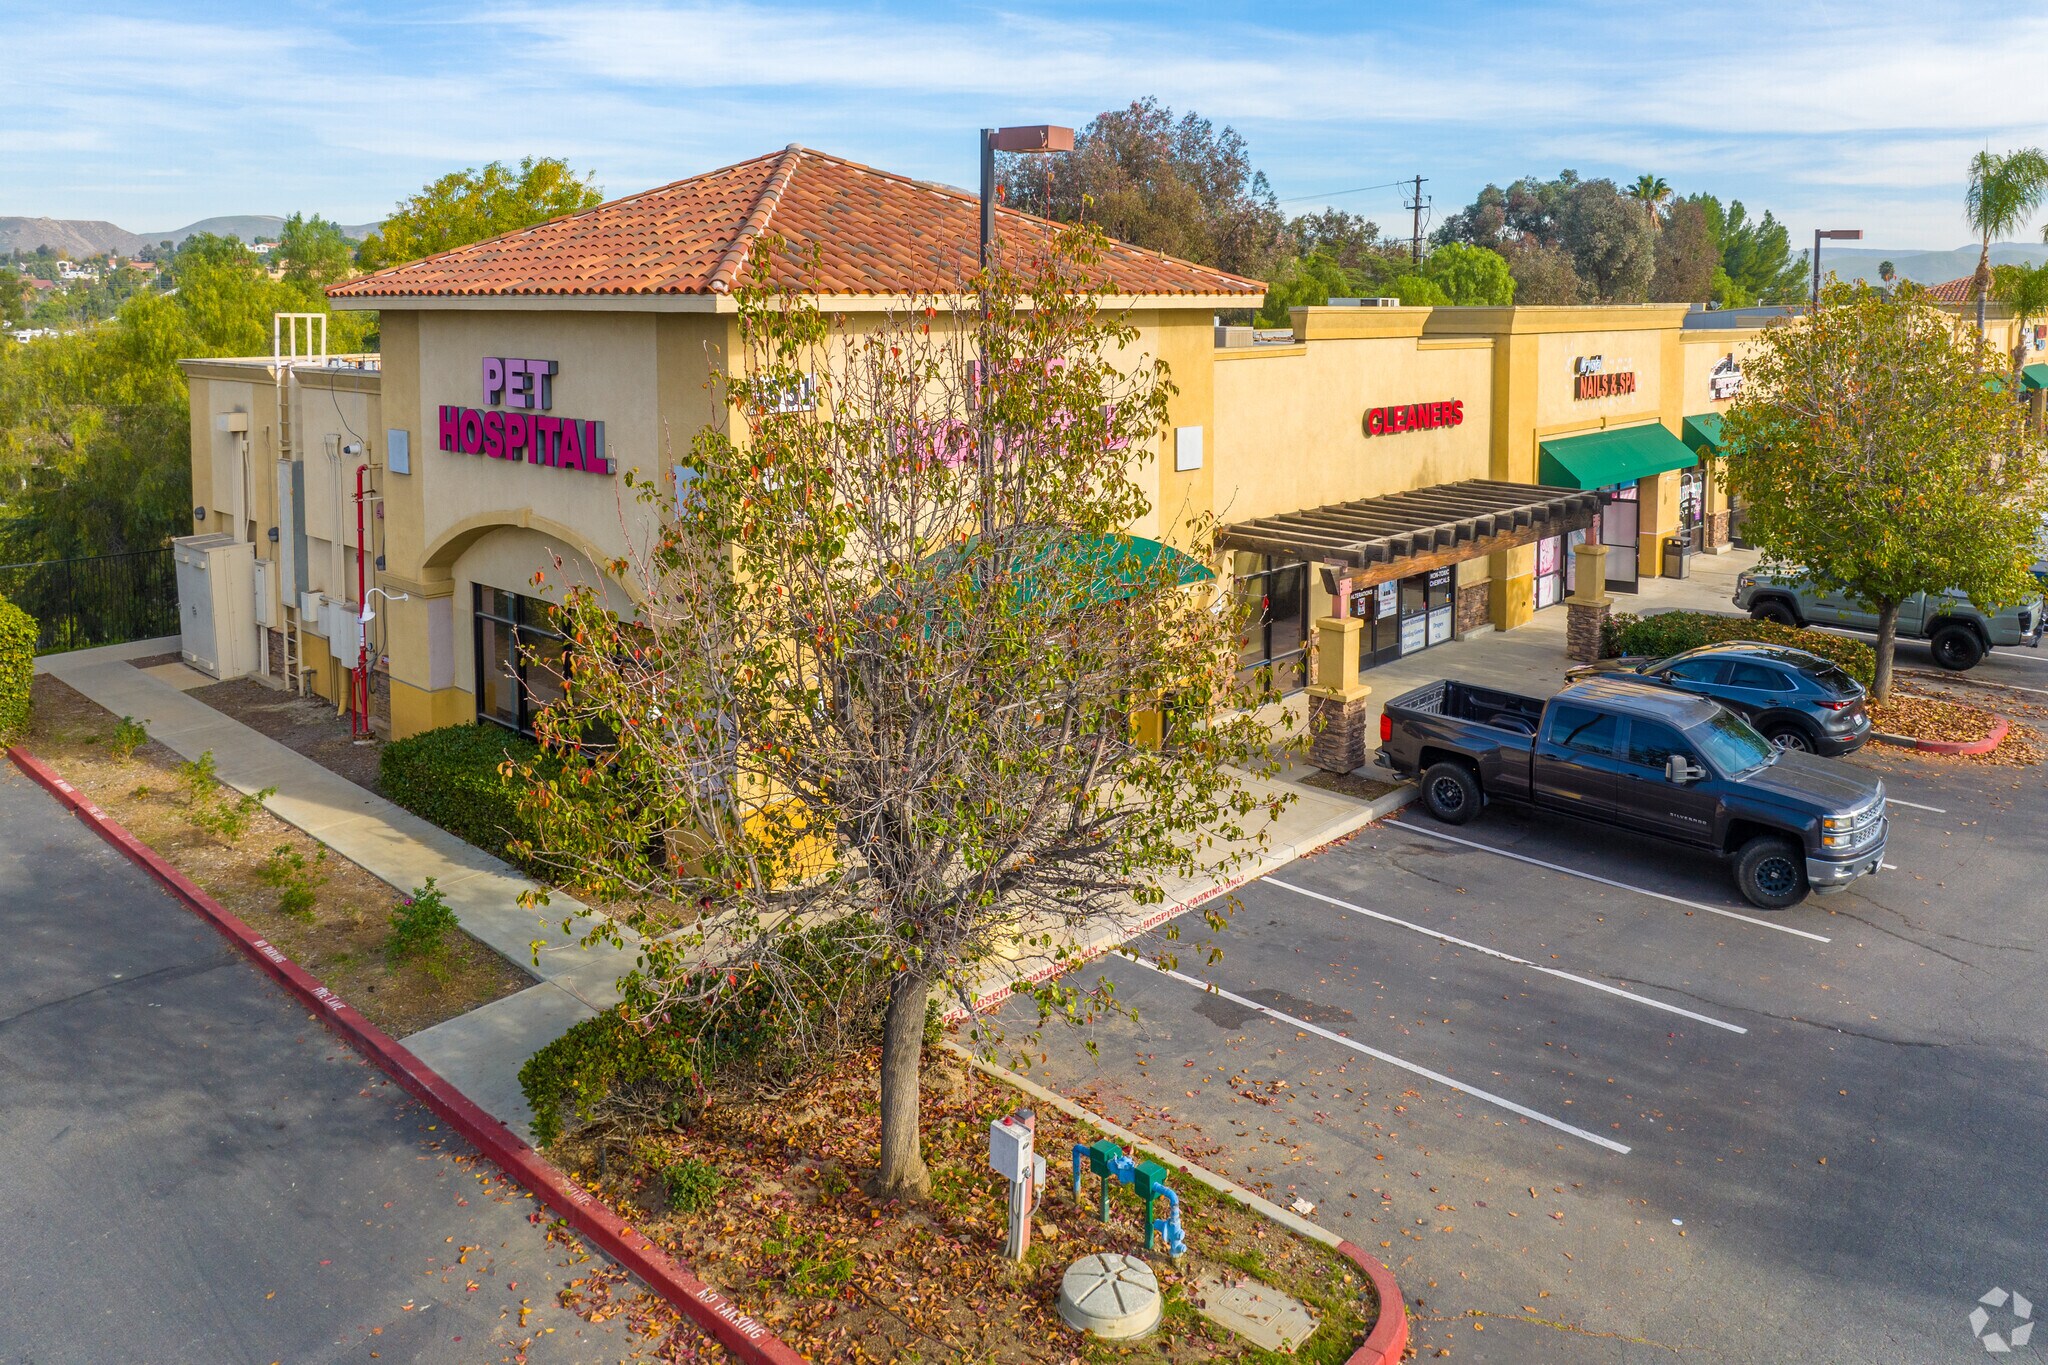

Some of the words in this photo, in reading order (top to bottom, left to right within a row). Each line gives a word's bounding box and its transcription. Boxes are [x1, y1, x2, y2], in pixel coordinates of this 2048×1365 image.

[482, 357, 556, 410] PET
[1579, 374, 1609, 399] NAILS
[1611, 374, 1618, 395] &
[1620, 372, 1636, 395] SPA
[1364, 399, 1464, 436] CLEANERS
[439, 405, 614, 475] HOSPITAL
[1143, 902, 1186, 929] HOSPITAL
[1187, 884, 1224, 908] PARKING
[1225, 874, 1245, 889] ONLY
[943, 1007, 964, 1024] PET
[696, 1286, 718, 1303] NO
